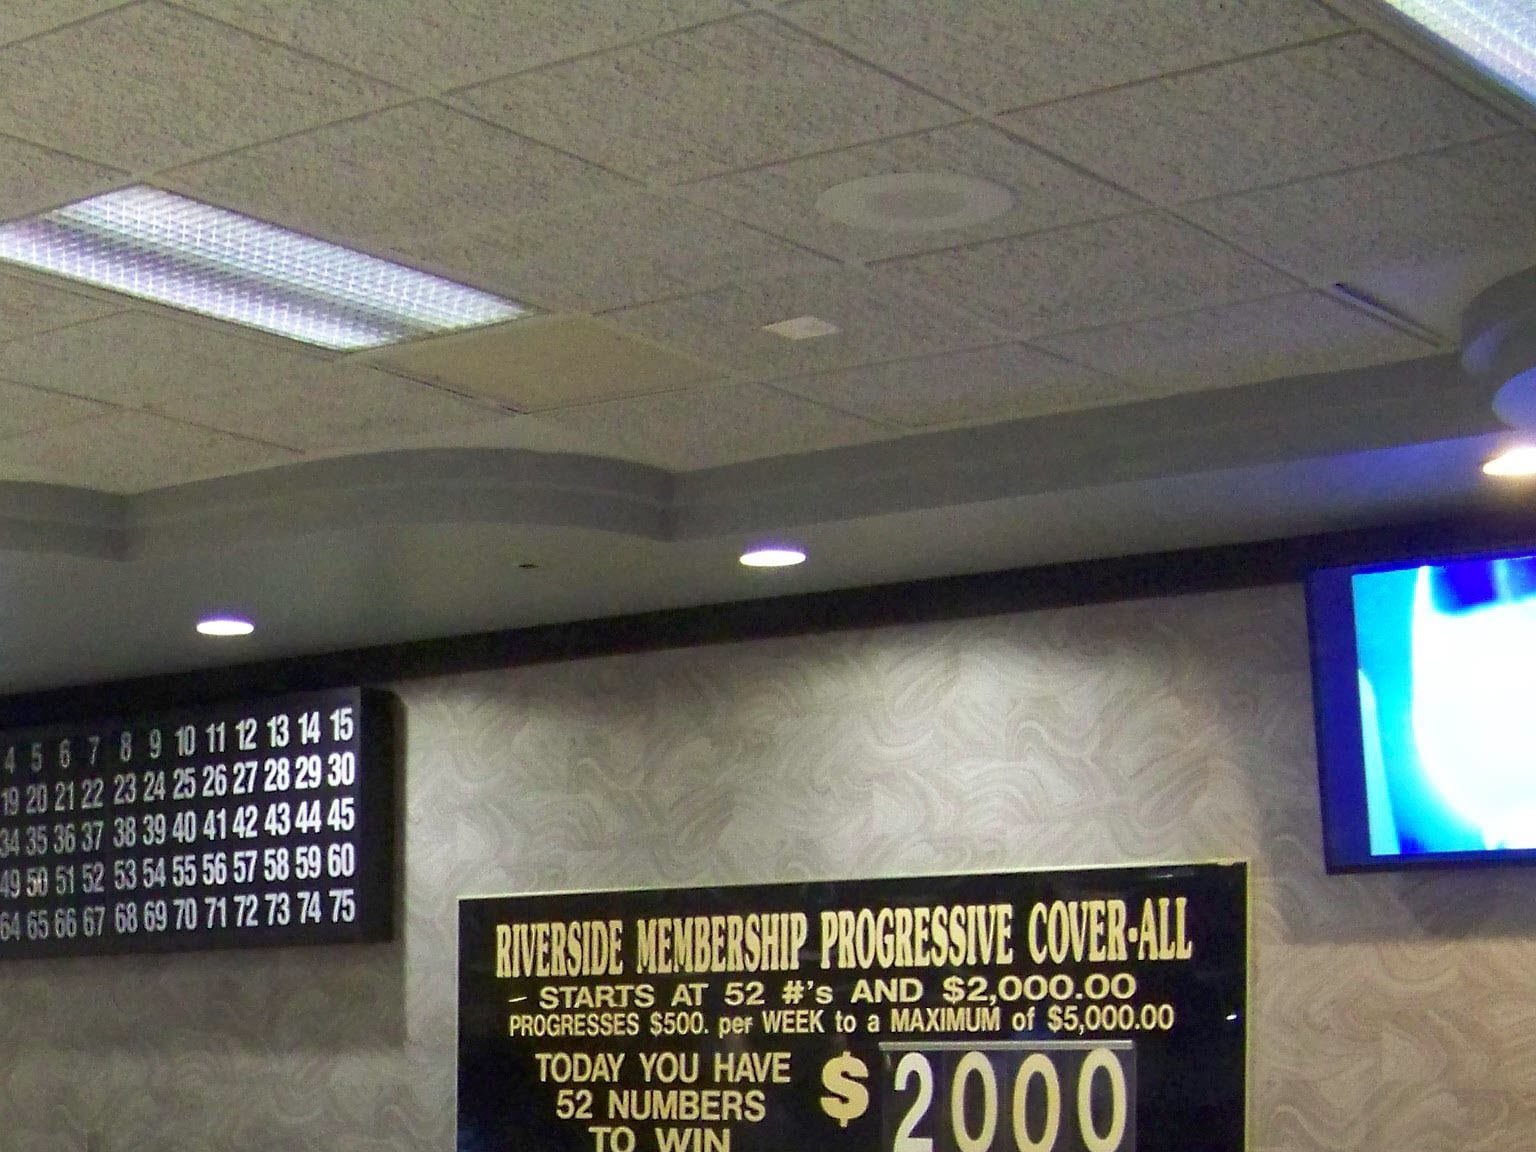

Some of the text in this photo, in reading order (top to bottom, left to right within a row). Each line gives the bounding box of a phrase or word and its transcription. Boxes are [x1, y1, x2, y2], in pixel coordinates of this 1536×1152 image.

[4, 747, 15, 774] 4
[32, 743, 42, 772] 5
[60, 739, 70, 768] 6
[89, 736, 100, 765] 7
[120, 732, 132, 762] 8
[150, 729, 161, 758] 9
[176, 726, 195, 756] 10
[206, 722, 224, 752] 11
[236, 718, 256, 750] 12
[267, 715, 289, 747] 13
[298, 712, 320, 744] 14
[330, 708, 353, 740] 15
[1, 787, 19, 815] 19
[26, 784, 47, 814] 20
[55, 782, 73, 811] 21
[82, 778, 104, 808] 22
[114, 774, 136, 804] 23
[144, 771, 166, 801] 24
[174, 768, 196, 799] 25
[203, 764, 226, 796] 26
[234, 761, 258, 794] 27
[264, 758, 290, 791] 28
[295, 755, 321, 788] 29
[328, 752, 354, 786] 30
[0, 828, 20, 858] 34
[26, 826, 48, 856] 35
[54, 824, 76, 854] 36
[82, 821, 104, 851] 37
[114, 816, 136, 847] 38
[143, 814, 166, 845] 39
[173, 811, 196, 842] 40
[204, 808, 226, 840] 41
[233, 806, 258, 838] 42
[265, 802, 290, 835] 43
[295, 800, 321, 833] 44
[328, 798, 354, 830] 45
[0, 869, 20, 898] 49
[27, 867, 48, 896] 50
[56, 866, 74, 894] 51
[83, 862, 104, 892] 52
[115, 859, 136, 889] 53
[143, 858, 166, 888] 54
[173, 855, 196, 886] 55
[203, 852, 226, 884] 56
[234, 850, 257, 882] 57
[264, 848, 289, 880] 58
[296, 846, 321, 879] 59
[328, 843, 354, 876] 60
[0, 912, 20, 940] 64
[27, 910, 48, 939] 65
[55, 908, 76, 938] 66
[83, 906, 105, 936] 67
[115, 902, 137, 933] 68
[144, 900, 167, 931] 69
[174, 898, 196, 929] 70
[205, 897, 226, 928] 71
[234, 894, 258, 926] 72
[265, 892, 290, 925] 73
[297, 892, 321, 923] 74
[329, 889, 355, 922] 75
[496, 897, 1193, 978] RIVERSIDE MEMBERSHIP PROGRESSIVE COVER-ALL
[539, 973, 1137, 1009] STARTS AT 52 #'s AND $2,000.00
[509, 1003, 1174, 1039] PROGRESSES $500. per WEEK to a MAXIMUM of $5,000.00
[535, 1052, 791, 1084] TODAY YOU HAVE
[556, 1089, 765, 1122] 52 NUMBERS
